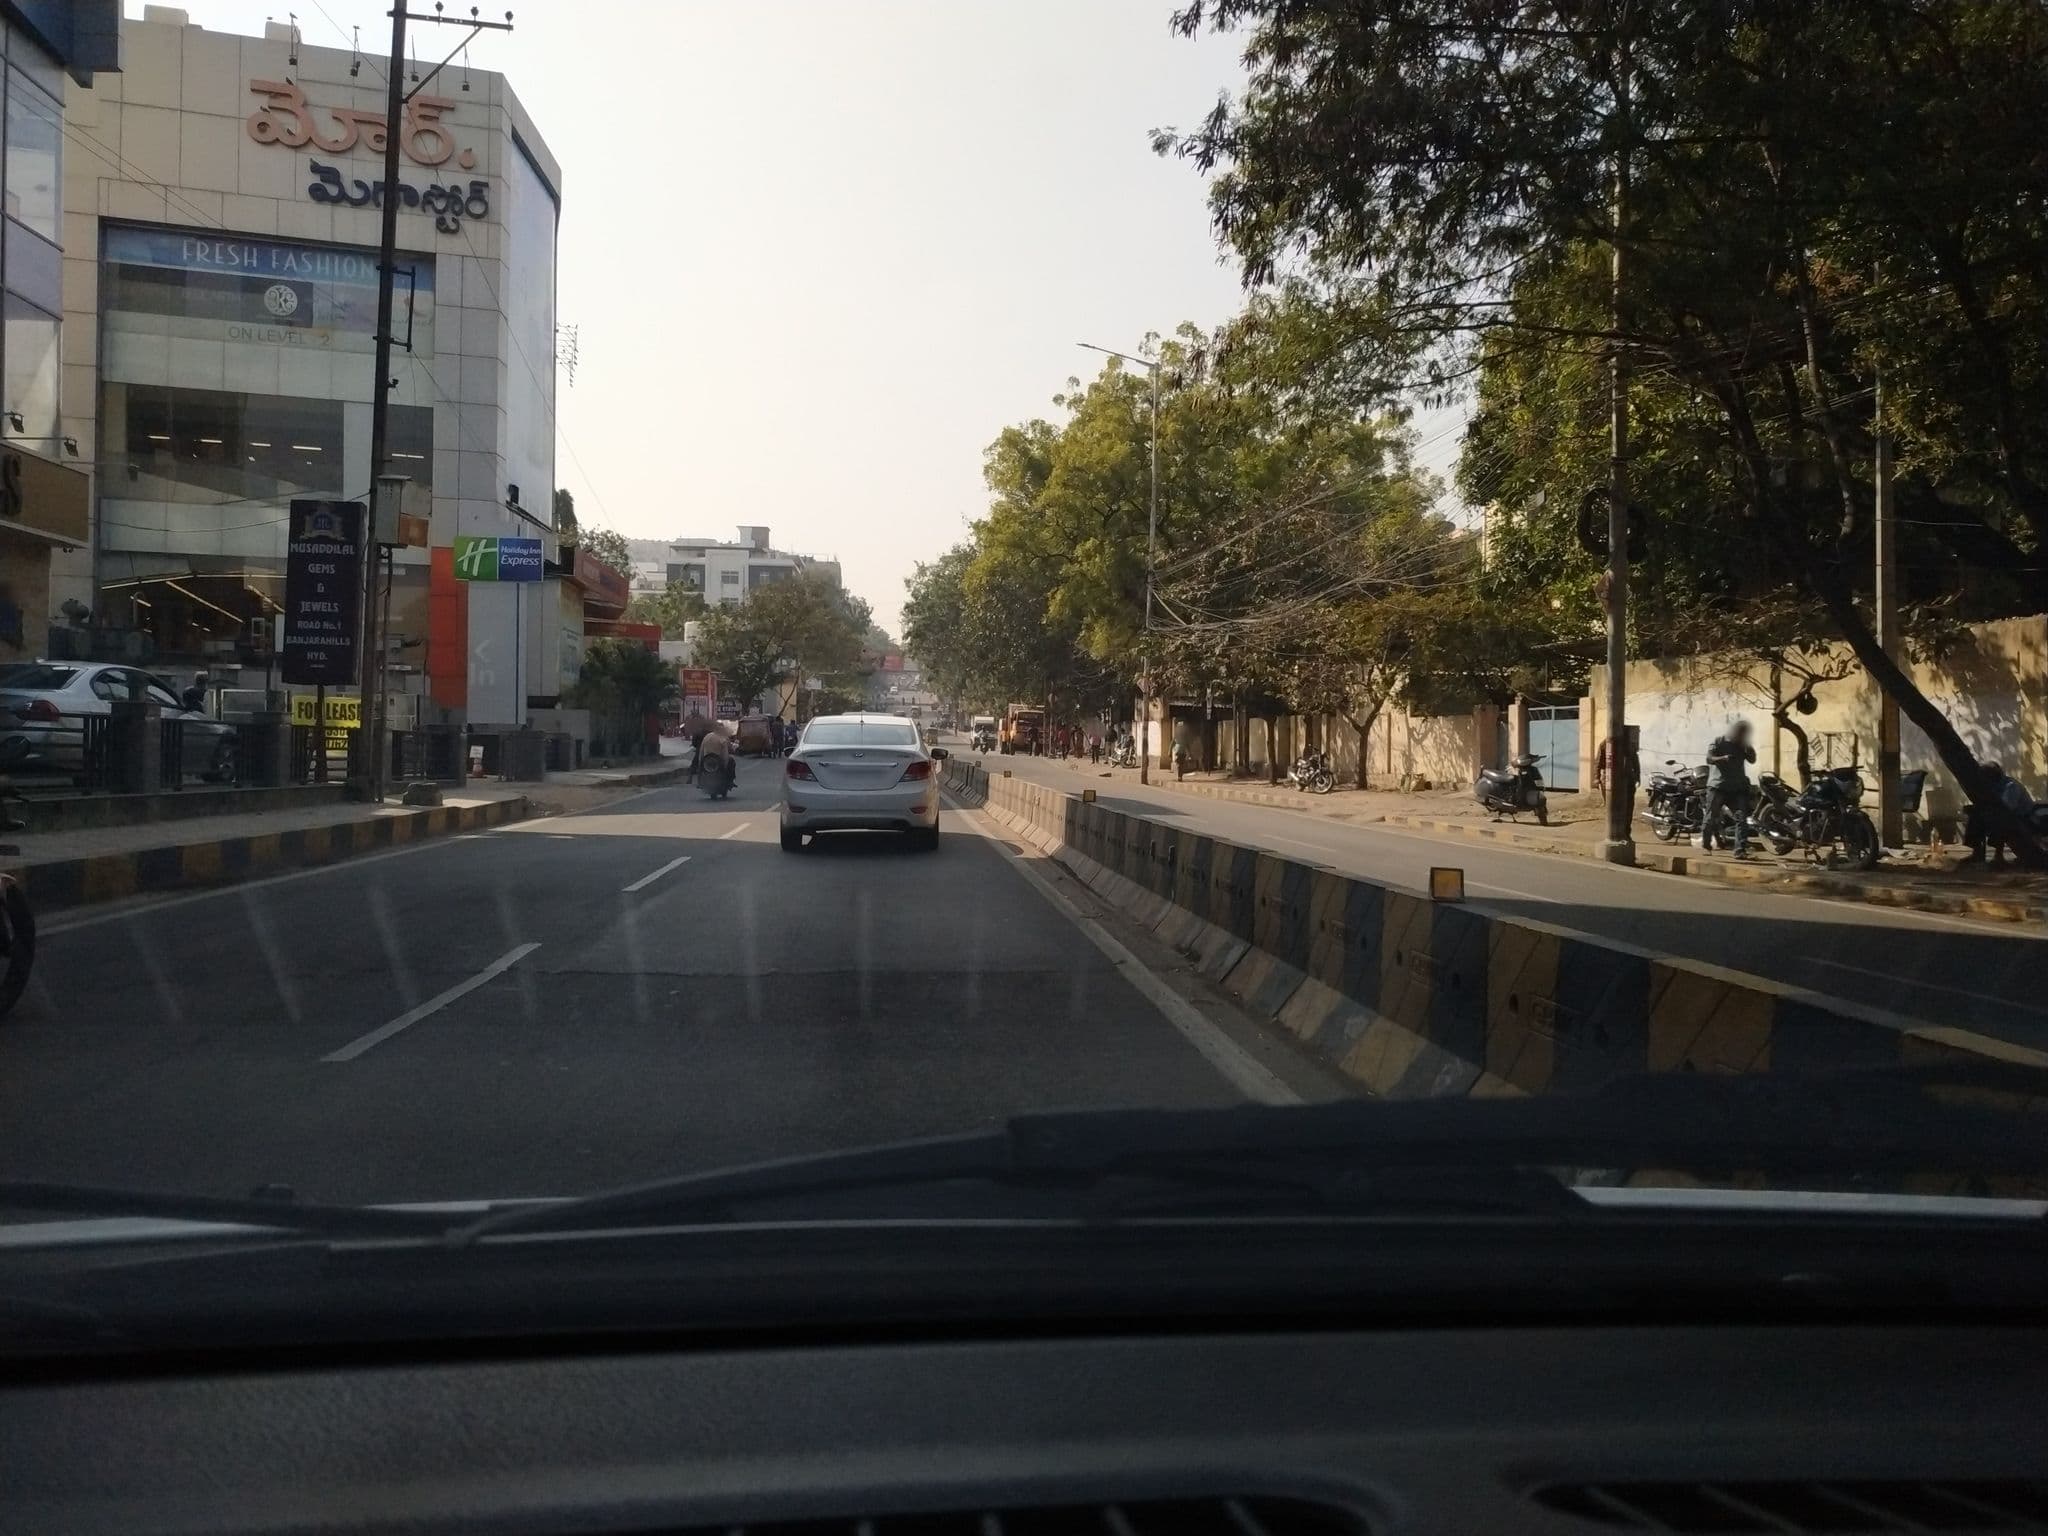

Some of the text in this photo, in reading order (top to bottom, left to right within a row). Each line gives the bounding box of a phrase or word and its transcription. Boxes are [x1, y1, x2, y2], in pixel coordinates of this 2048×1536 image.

[182, 239, 375, 279] FRESH FASHION
[228, 325, 253, 343] ON
[257, 327, 306, 346] LEVEL
[290, 542, 355, 555] MUSADDILAL
[500, 545, 529, 556] Holiday
[500, 554, 540, 567] Express
[308, 563, 336, 575] GEMS
[300, 601, 339, 614] JEWELS
[297, 621, 320, 630] ROAD
[286, 636, 351, 646] BANJARAHILLS
[297, 701, 318, 721] FO
